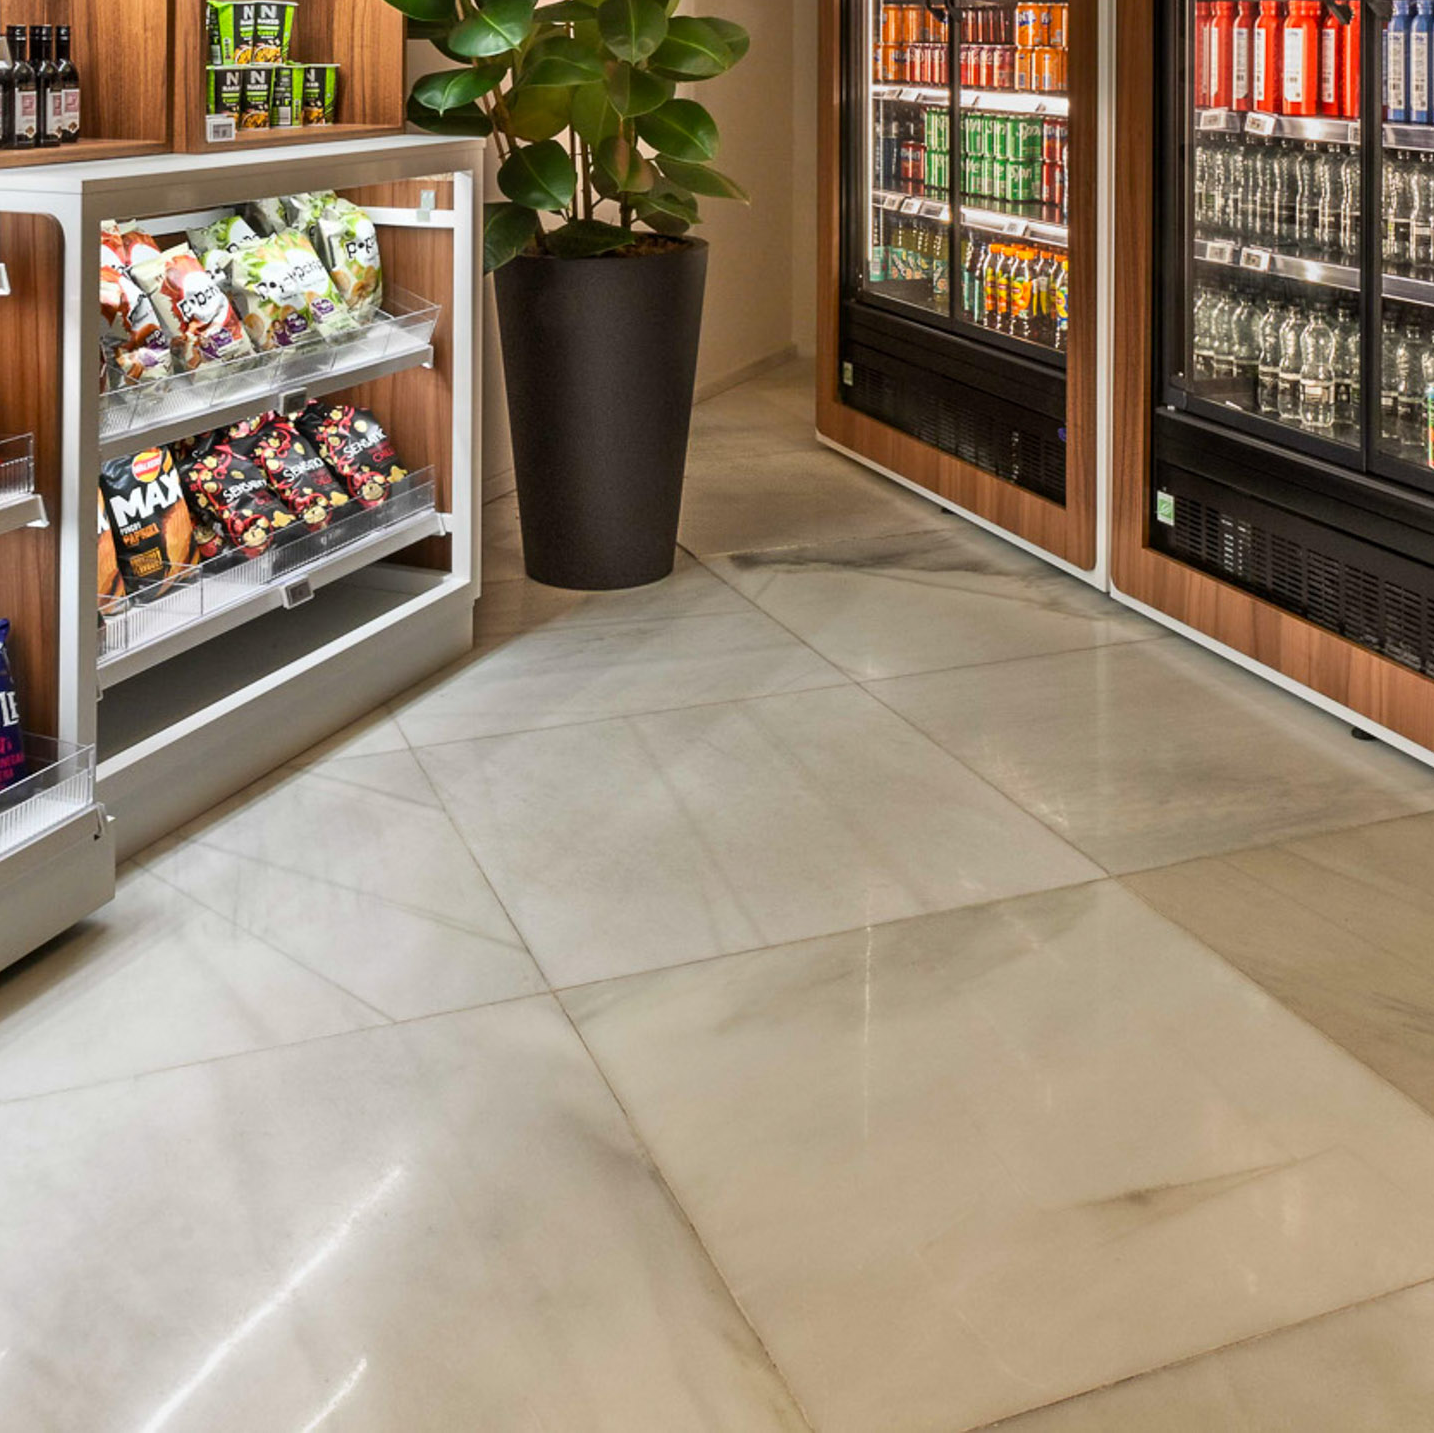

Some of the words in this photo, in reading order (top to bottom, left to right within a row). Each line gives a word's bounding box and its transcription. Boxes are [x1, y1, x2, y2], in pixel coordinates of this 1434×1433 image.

[261, 5, 277, 18] N
[226, 72, 239, 84] N
[250, 71, 265, 83] N
[109, 466, 183, 527] MAX
